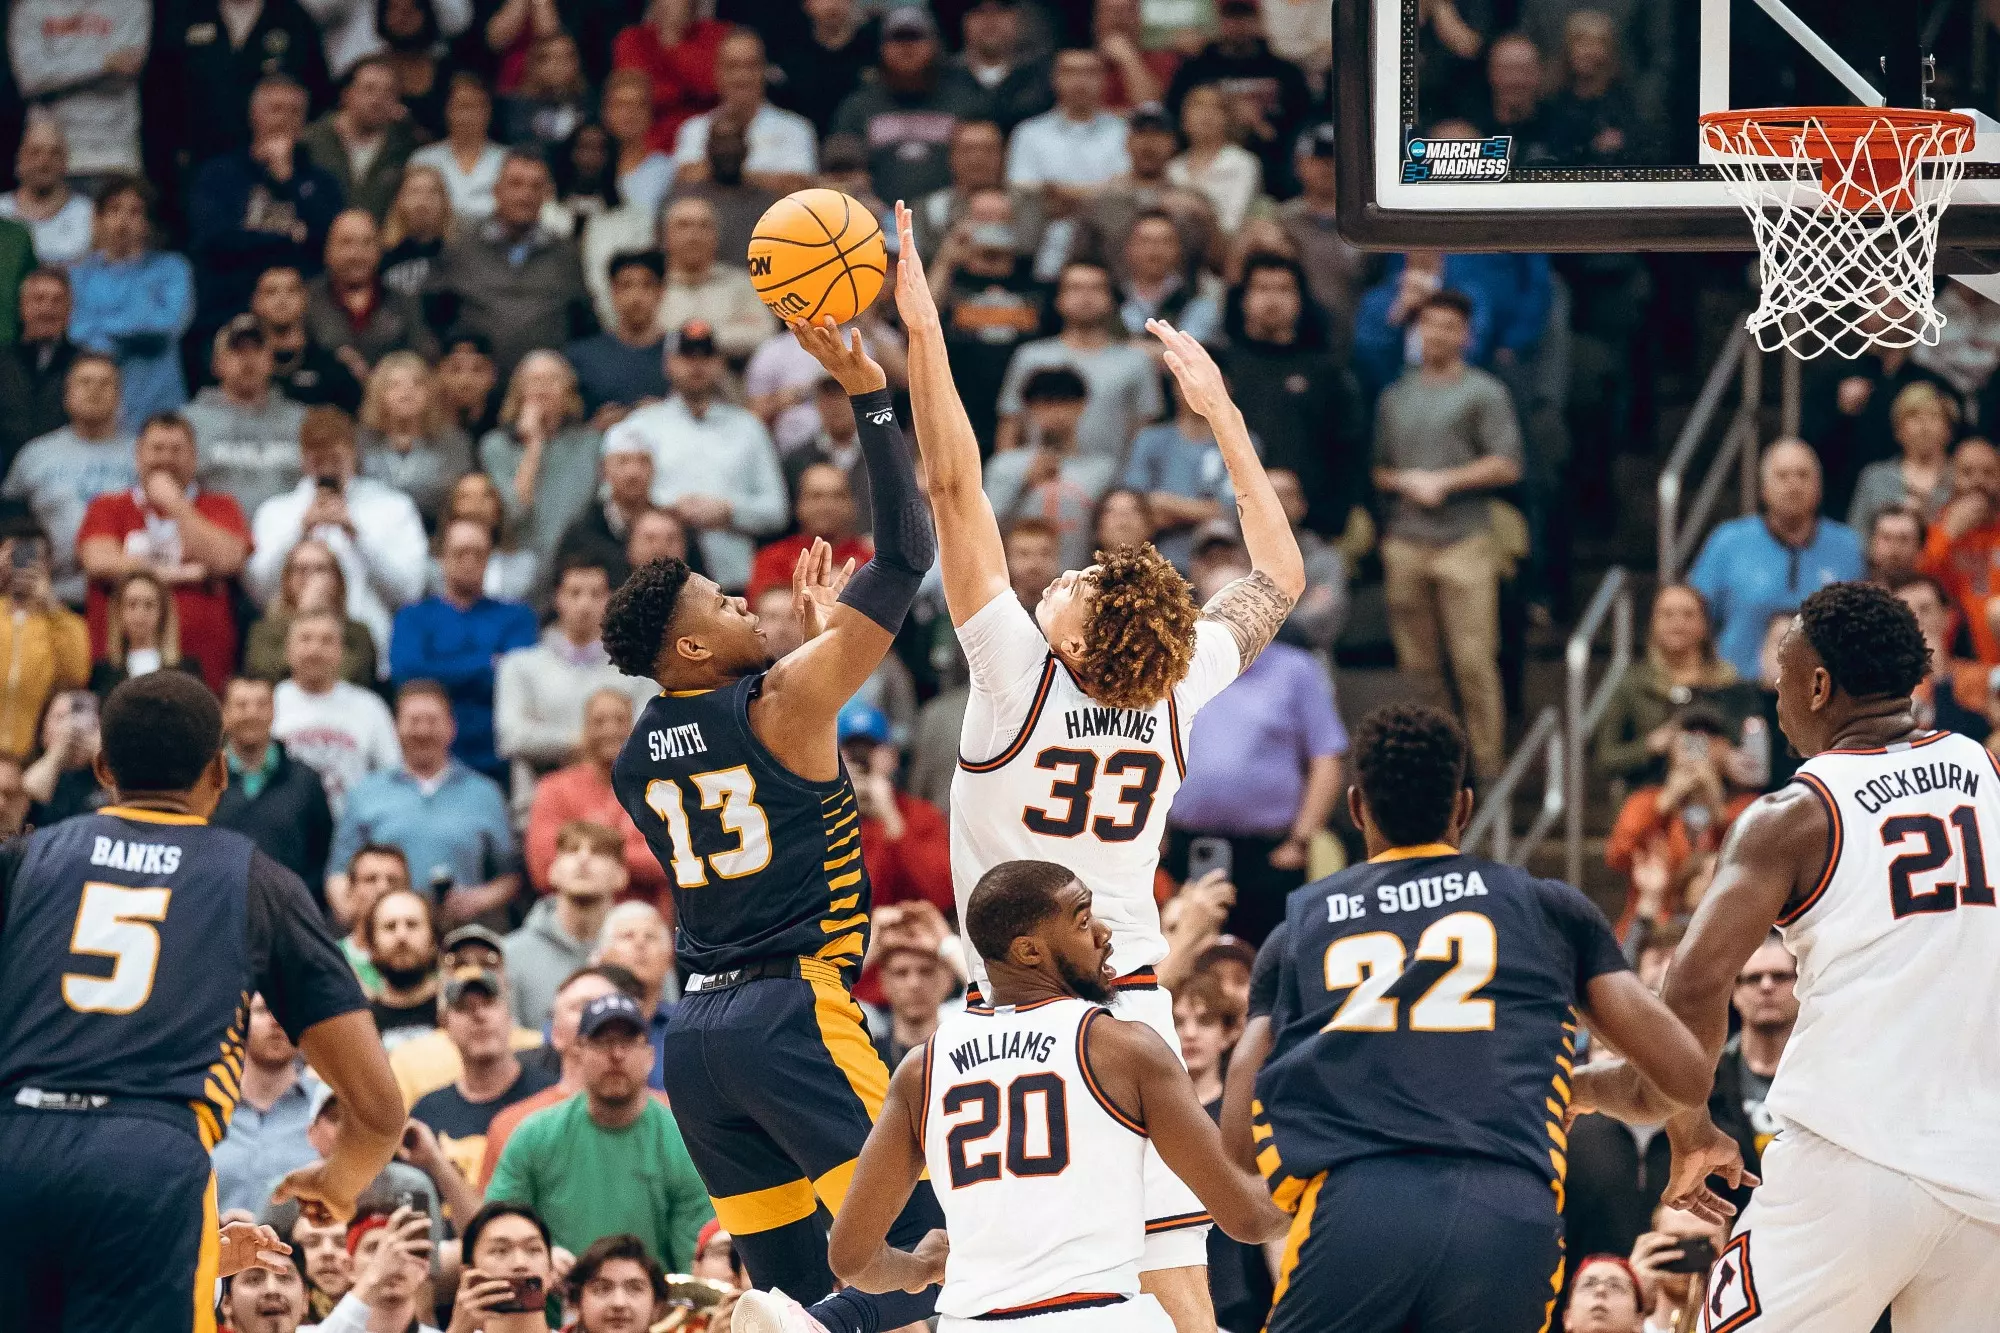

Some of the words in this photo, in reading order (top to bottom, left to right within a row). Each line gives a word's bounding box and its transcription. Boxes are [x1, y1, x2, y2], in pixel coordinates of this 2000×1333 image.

[1426, 142, 1481, 158] MARCH
[1432, 159, 1507, 175] MADNESS
[648, 722, 708, 762] SMITH
[1065, 707, 1157, 744] HAWKINS
[1022, 745, 1165, 843] 33
[1854, 762, 1979, 814] COCKBURN
[645, 763, 773, 888] 13
[90, 836, 182, 874] BANKS
[1879, 804, 1996, 920] 21
[1377, 871, 1489, 914] SOUSA
[61, 880, 172, 1015] 5
[1319, 910, 1498, 1034] 22
[949, 1031, 1056, 1074] WILLIAMS
[942, 1071, 1070, 1190] 20
